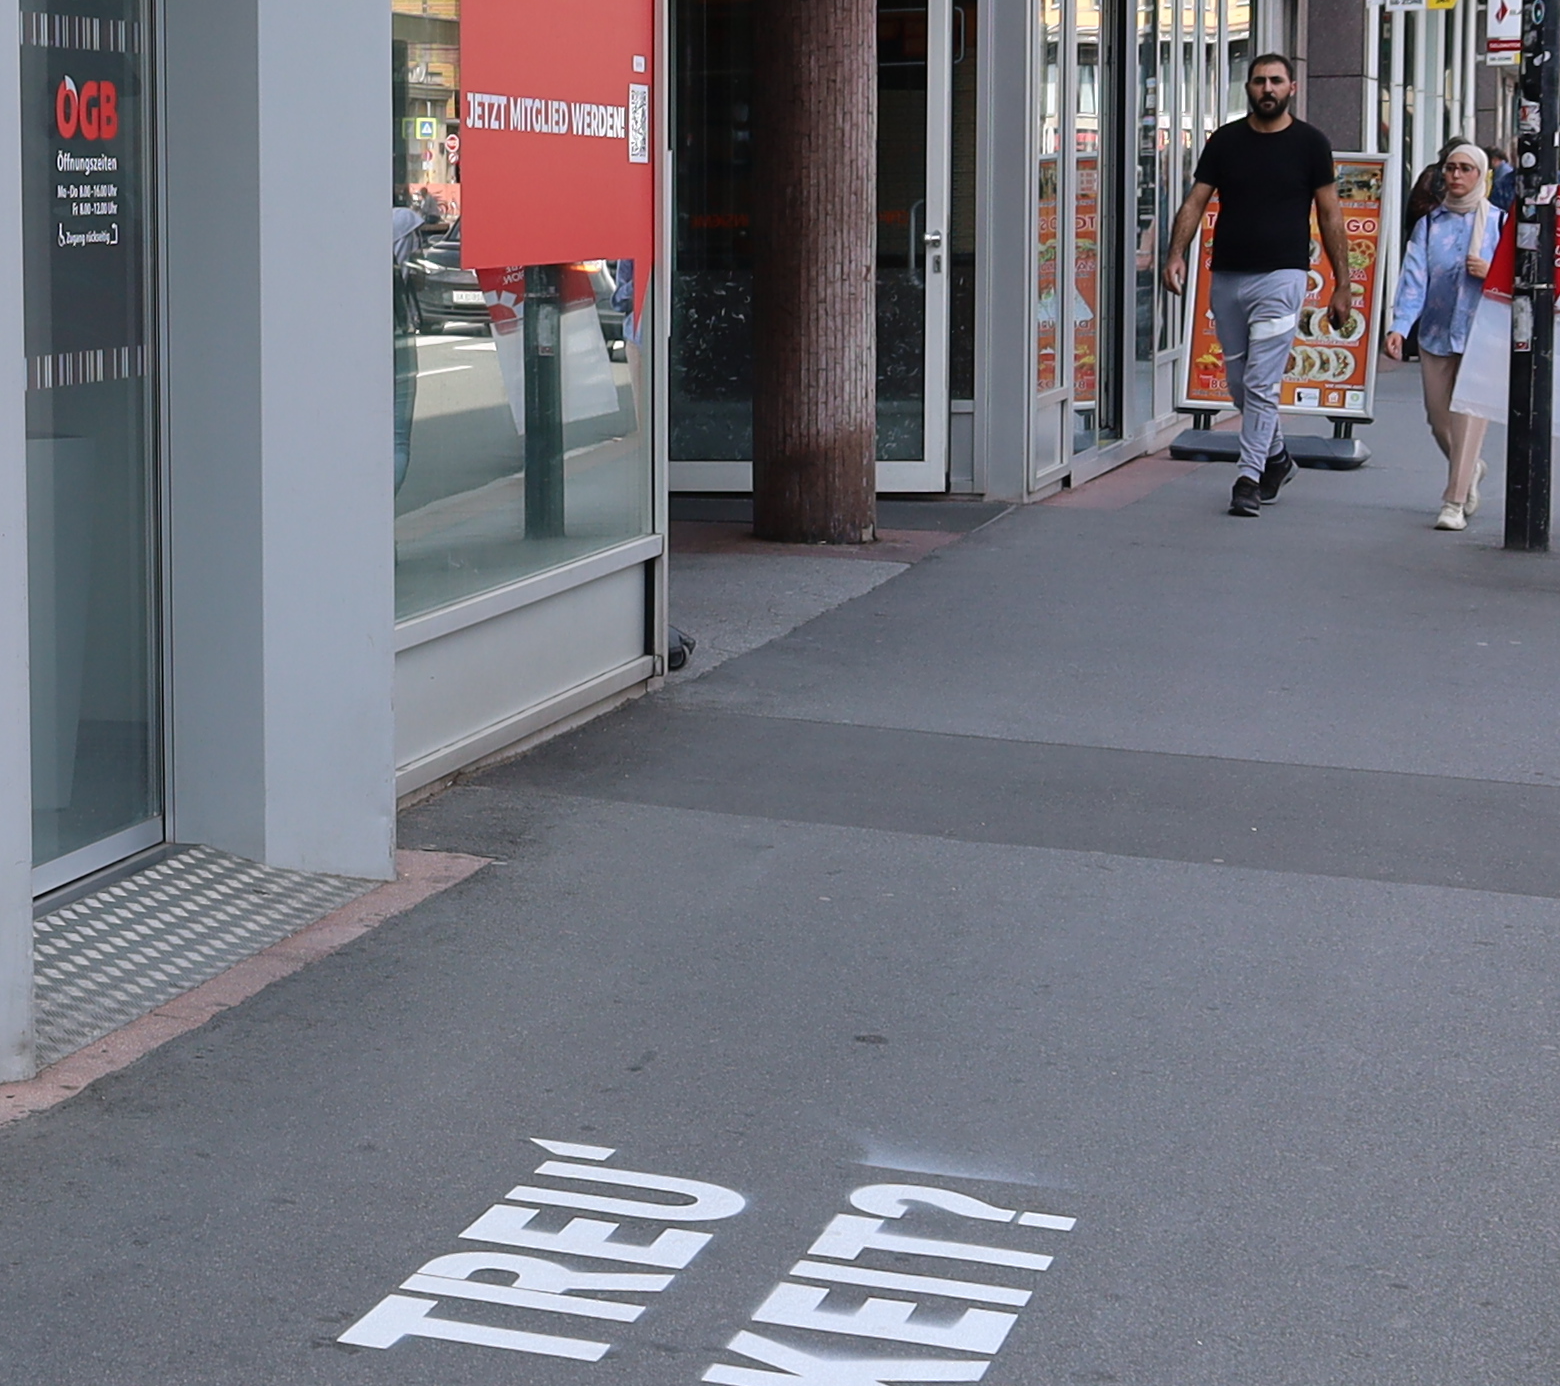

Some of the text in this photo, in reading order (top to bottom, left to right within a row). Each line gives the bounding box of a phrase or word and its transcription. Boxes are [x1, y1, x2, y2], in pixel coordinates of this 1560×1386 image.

[466, 92, 626, 139] JETZT MITGLIED WERDEN!
[56, 150, 118, 176] Öffnungszeiten
[1346, 218, 1377, 234] GO
